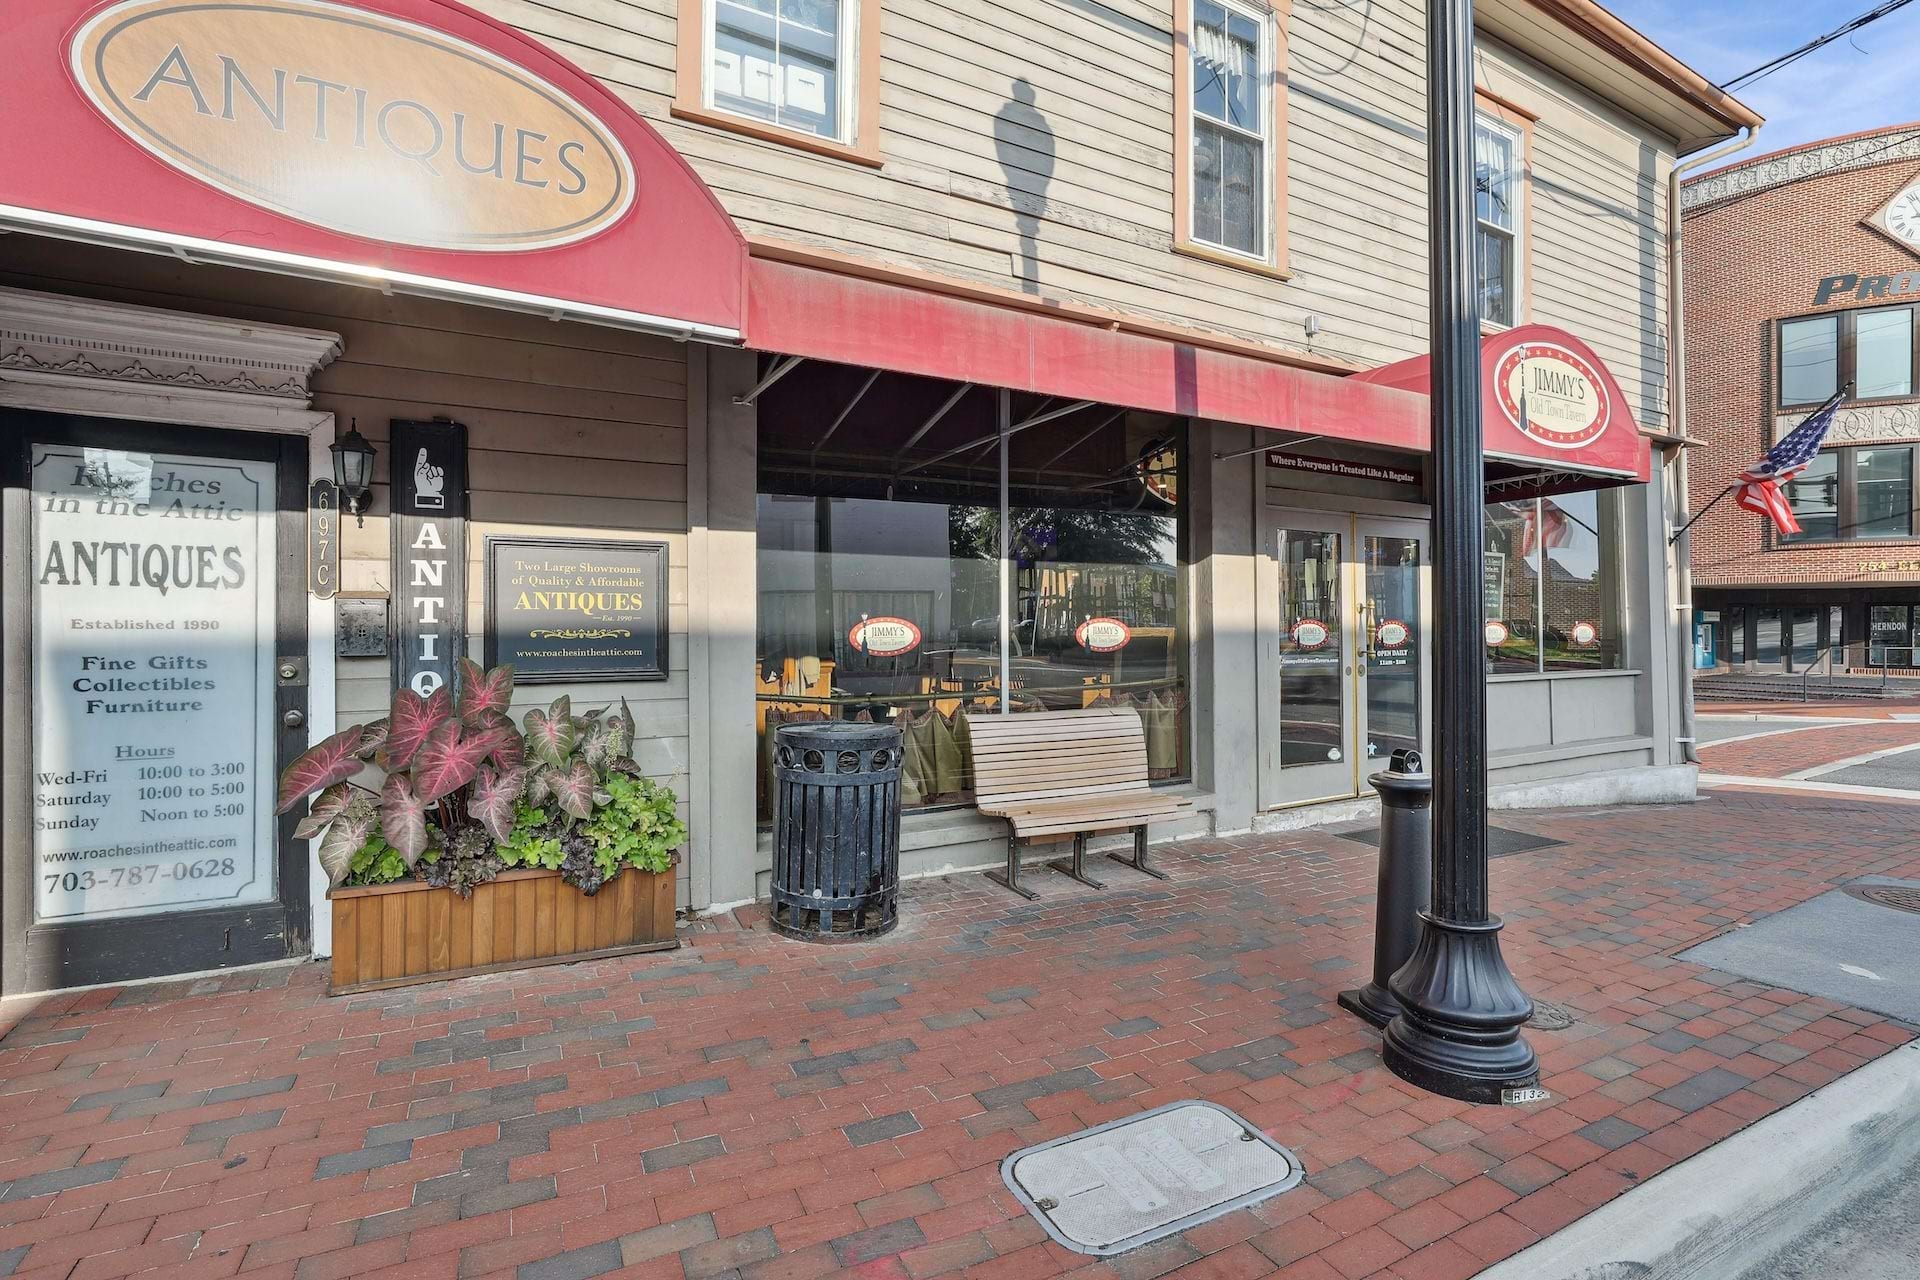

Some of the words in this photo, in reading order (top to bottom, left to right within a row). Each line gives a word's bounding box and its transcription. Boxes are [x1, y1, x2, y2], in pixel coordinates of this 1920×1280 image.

[133, 44, 589, 196] ANTIQUES
[1533, 366, 1585, 400] JIMMY'S
[1530, 396, 1544, 415] Old
[1545, 400, 1564, 418] Town
[70, 464, 221, 495] Rches
[1270, 454, 1296, 466] Where
[1297, 458, 1331, 471] Everyone
[1331, 462, 1339, 472] Is
[1339, 463, 1366, 476] Treated
[1366, 467, 1382, 478] Like
[1382, 470, 1388, 479] A
[1389, 471, 1415, 482] Regular
[43, 491, 81, 514] in
[96, 495, 150, 517] the
[160, 498, 244, 522] Attic
[317, 491, 329, 586] 697C
[39, 540, 246, 597] ANTIQUES
[514, 560, 541, 572] Two
[544, 561, 577, 575] Large
[579, 562, 642, 574] Showrooms
[1858, 561, 1887, 572] 754
[511, 575, 525, 585] of
[528, 575, 572, 588] Quality
[575, 576, 585, 586] &
[588, 577, 645, 588] Affordable
[513, 591, 643, 615] ANTIQUES
[70, 618, 175, 631] Established
[183, 619, 221, 631] 1990
[871, 626, 905, 638] JIMMY'S
[1872, 622, 1908, 631] HERNDON
[81, 656, 137, 671] Fine
[148, 655, 208, 670] Gifts
[516, 648, 643, 657] www.roachesintheattic.com
[1392, 649, 1409, 657] DAILY
[72, 677, 216, 693] Collectibles
[86, 699, 204, 714] Furniture
[115, 745, 176, 759] Hours
[37, 769, 108, 787] Wed-Fri
[137, 765, 182, 780] 10:00
[189, 766, 205, 778] to
[210, 762, 245, 776] 3:00
[36, 792, 111, 809] Saturday
[137, 785, 183, 801] 10:00
[189, 786, 205, 797] to
[210, 781, 245, 796] 5:00
[34, 815, 100, 832] Sunday
[140, 808, 188, 823] Noon
[193, 808, 208, 819] to
[213, 803, 245, 817] 5:00
[43, 836, 237, 863] www.roachesintheattic.com
[44, 857, 235, 894] 703-787-0628
